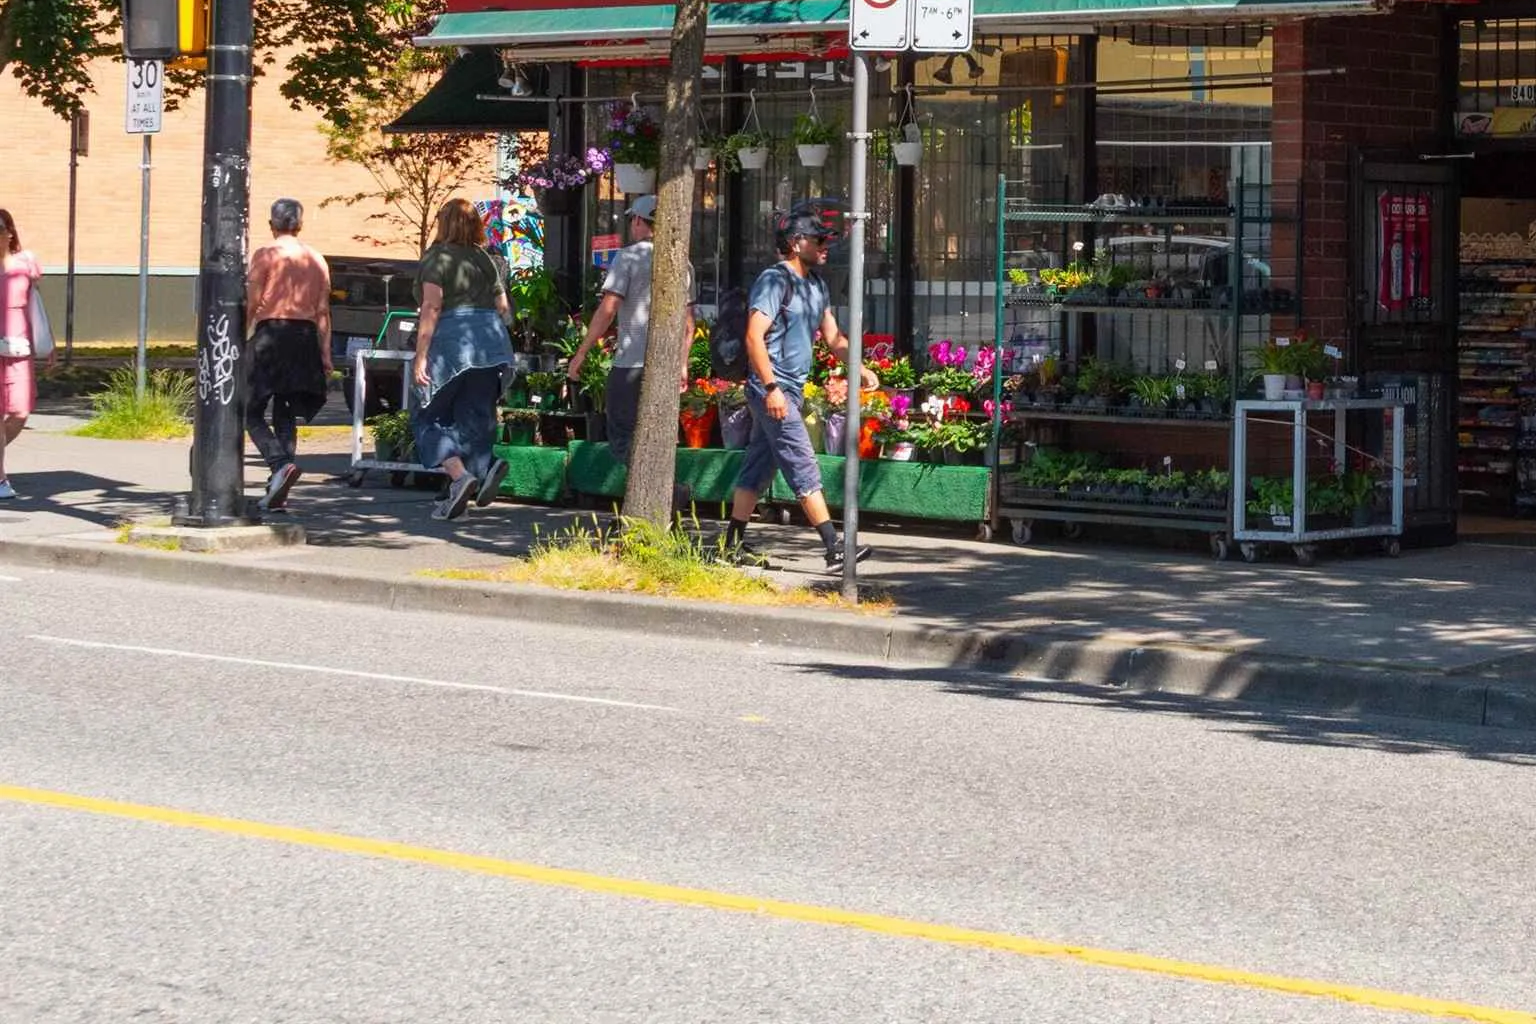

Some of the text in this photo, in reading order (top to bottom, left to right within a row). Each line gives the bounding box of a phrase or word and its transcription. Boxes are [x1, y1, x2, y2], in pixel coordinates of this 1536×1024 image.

[132, 60, 158, 89] 30
[1512, 85, 1535, 100] 940
[143, 103, 157, 113] ALL
[133, 118, 154, 129] TIMES
